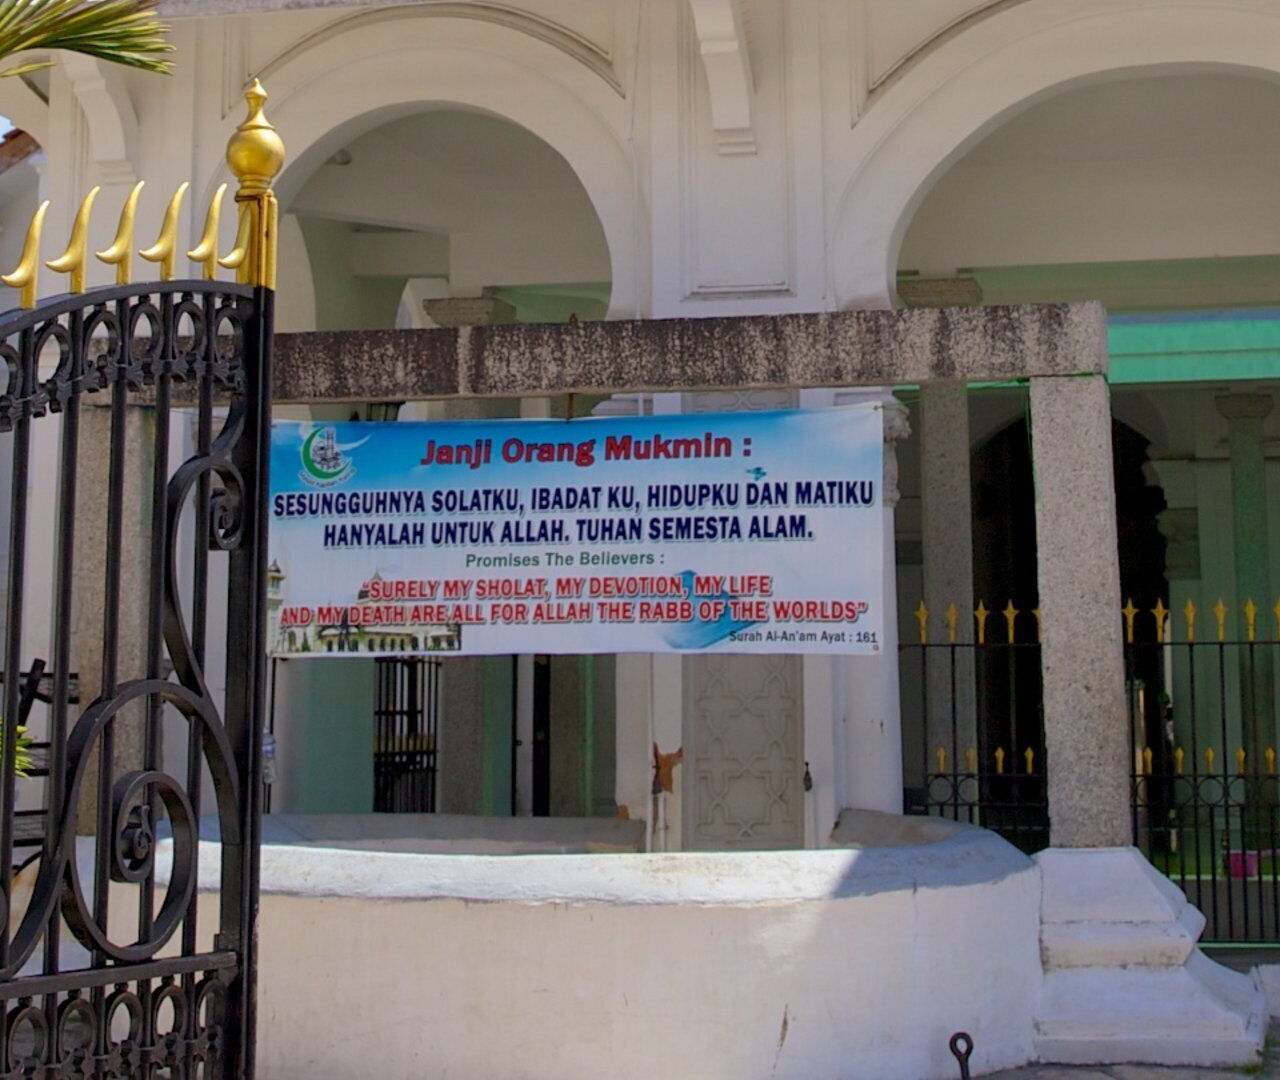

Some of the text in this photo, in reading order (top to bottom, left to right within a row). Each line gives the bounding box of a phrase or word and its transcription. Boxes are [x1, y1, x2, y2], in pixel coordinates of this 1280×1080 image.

[420, 432, 752, 469] Janji Orang Mukmin :
[273, 480, 873, 518] SESUNGGUHNYA SOLATKU, IBADAT KU, HIDUPKU DAN MATIKU
[324, 514, 813, 547] HANYALAH UNTUK ALLAH. TUHAN SEMESTA ALAM.
[466, 553, 540, 568] Promises
[545, 552, 573, 566] The
[579, 551, 655, 566] Believers
[443, 578, 472, 599] MY
[476, 577, 551, 603] SHOLAT,
[556, 577, 584, 598] MY
[589, 576, 689, 599] DEVOTION,
[694, 576, 726, 596] MY
[729, 575, 773, 595] LIFE
[280, 607, 312, 626] AND
[317, 606, 348, 626] MY
[349, 605, 404, 625] DEATH
[411, 605, 446, 624] ARE
[452, 603, 485, 623] ALL
[491, 603, 527, 623] FOR
[533, 602, 591, 622] ALLAH
[597, 602, 633, 620] THE
[639, 601, 693, 620] RABB
[699, 601, 725, 620] OF
[731, 601, 767, 619] THE
[729, 631, 763, 643] Surah
[820, 631, 846, 644] Ayat
[856, 631, 878, 643] 161
